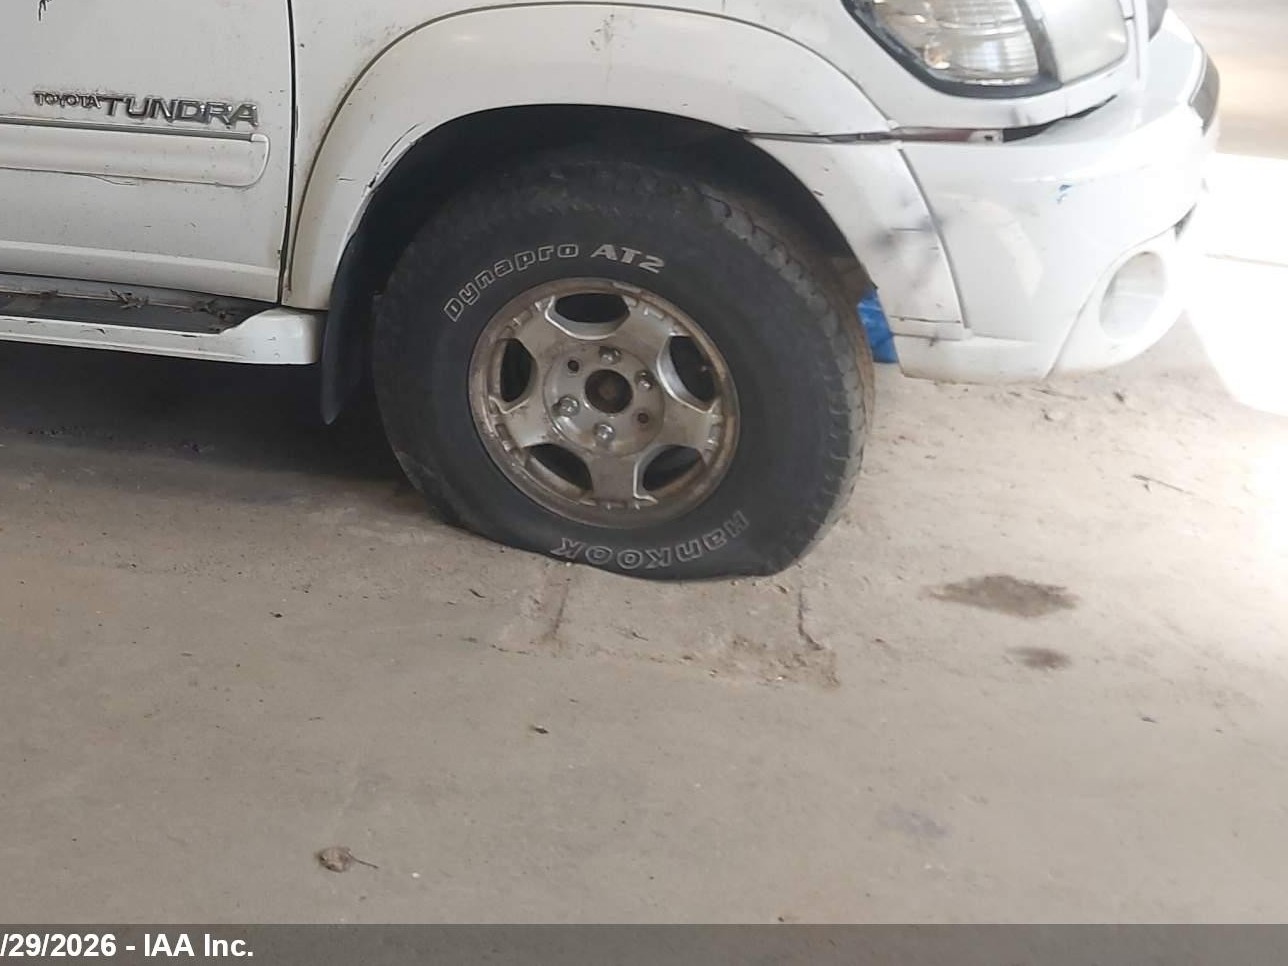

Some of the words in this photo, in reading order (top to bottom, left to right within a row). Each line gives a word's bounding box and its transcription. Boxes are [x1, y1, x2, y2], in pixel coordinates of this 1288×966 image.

[34, 91, 102, 110] TOYOTA
[100, 94, 260, 130] TUNDRA
[443, 243, 579, 323] Dynapro
[590, 243, 665, 274] AT2
